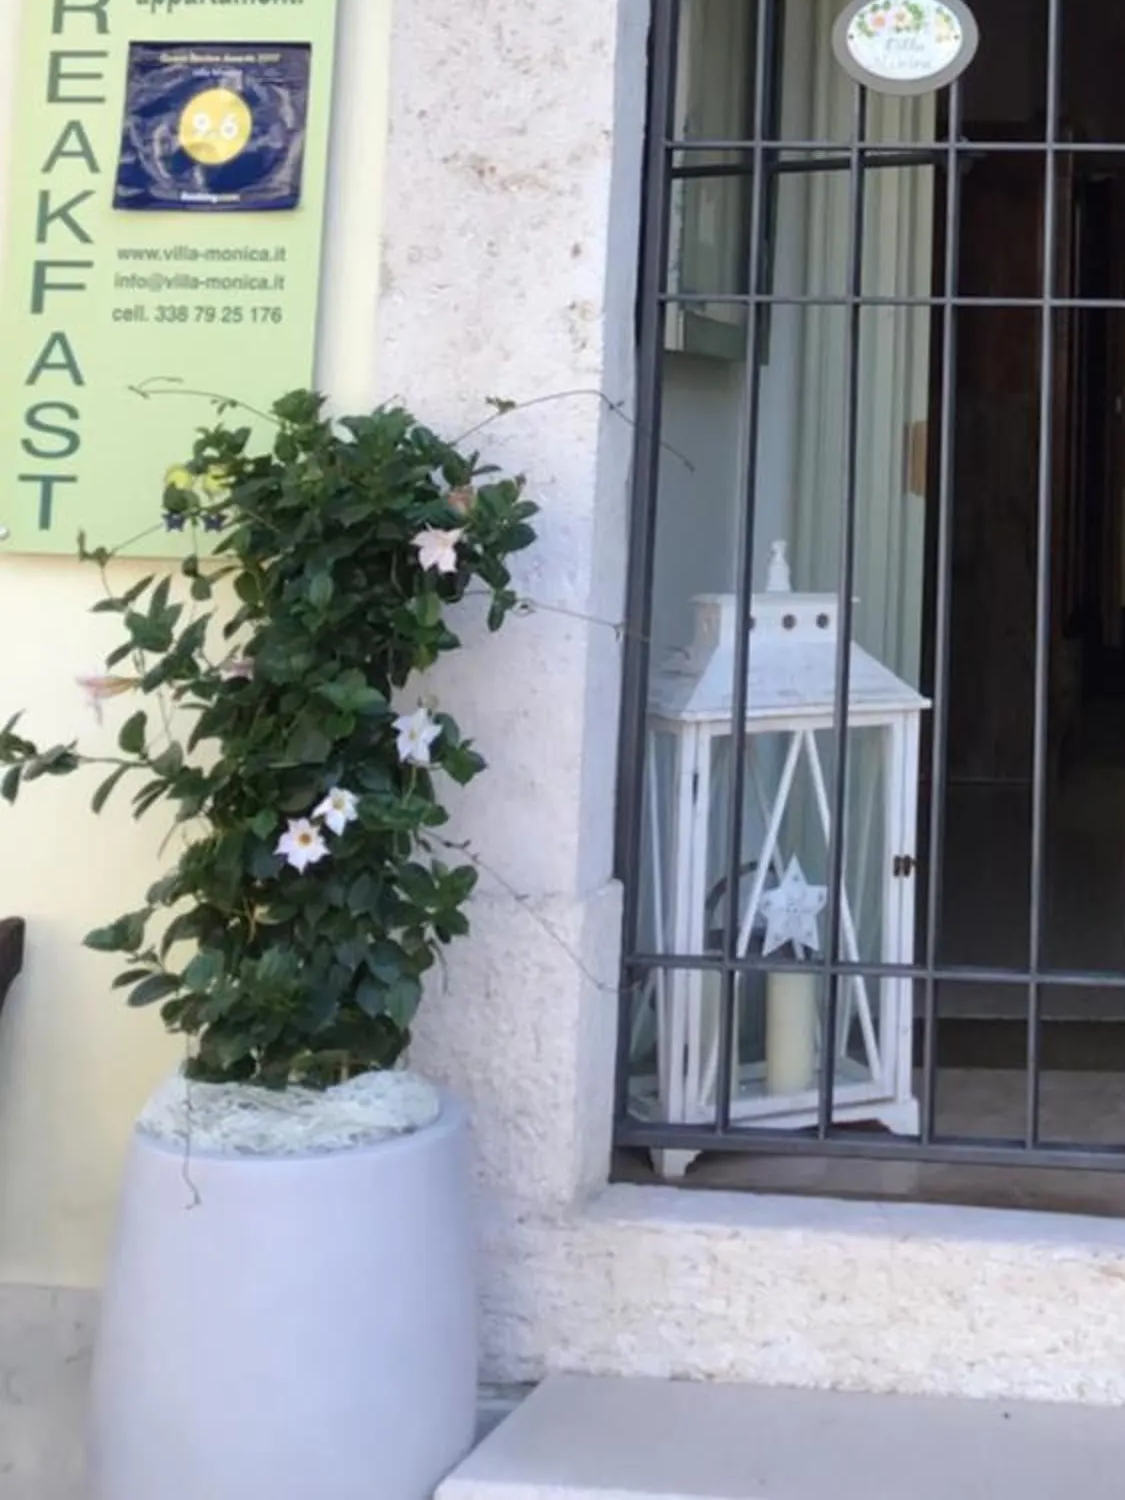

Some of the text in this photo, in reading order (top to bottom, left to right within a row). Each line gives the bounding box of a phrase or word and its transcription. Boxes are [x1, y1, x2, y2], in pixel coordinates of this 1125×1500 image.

[117, 245, 287, 262] www.villa-monica.it
[113, 272, 285, 292] info@villa-monica.it
[111, 304, 283, 324] cell. 338 79 25 176
